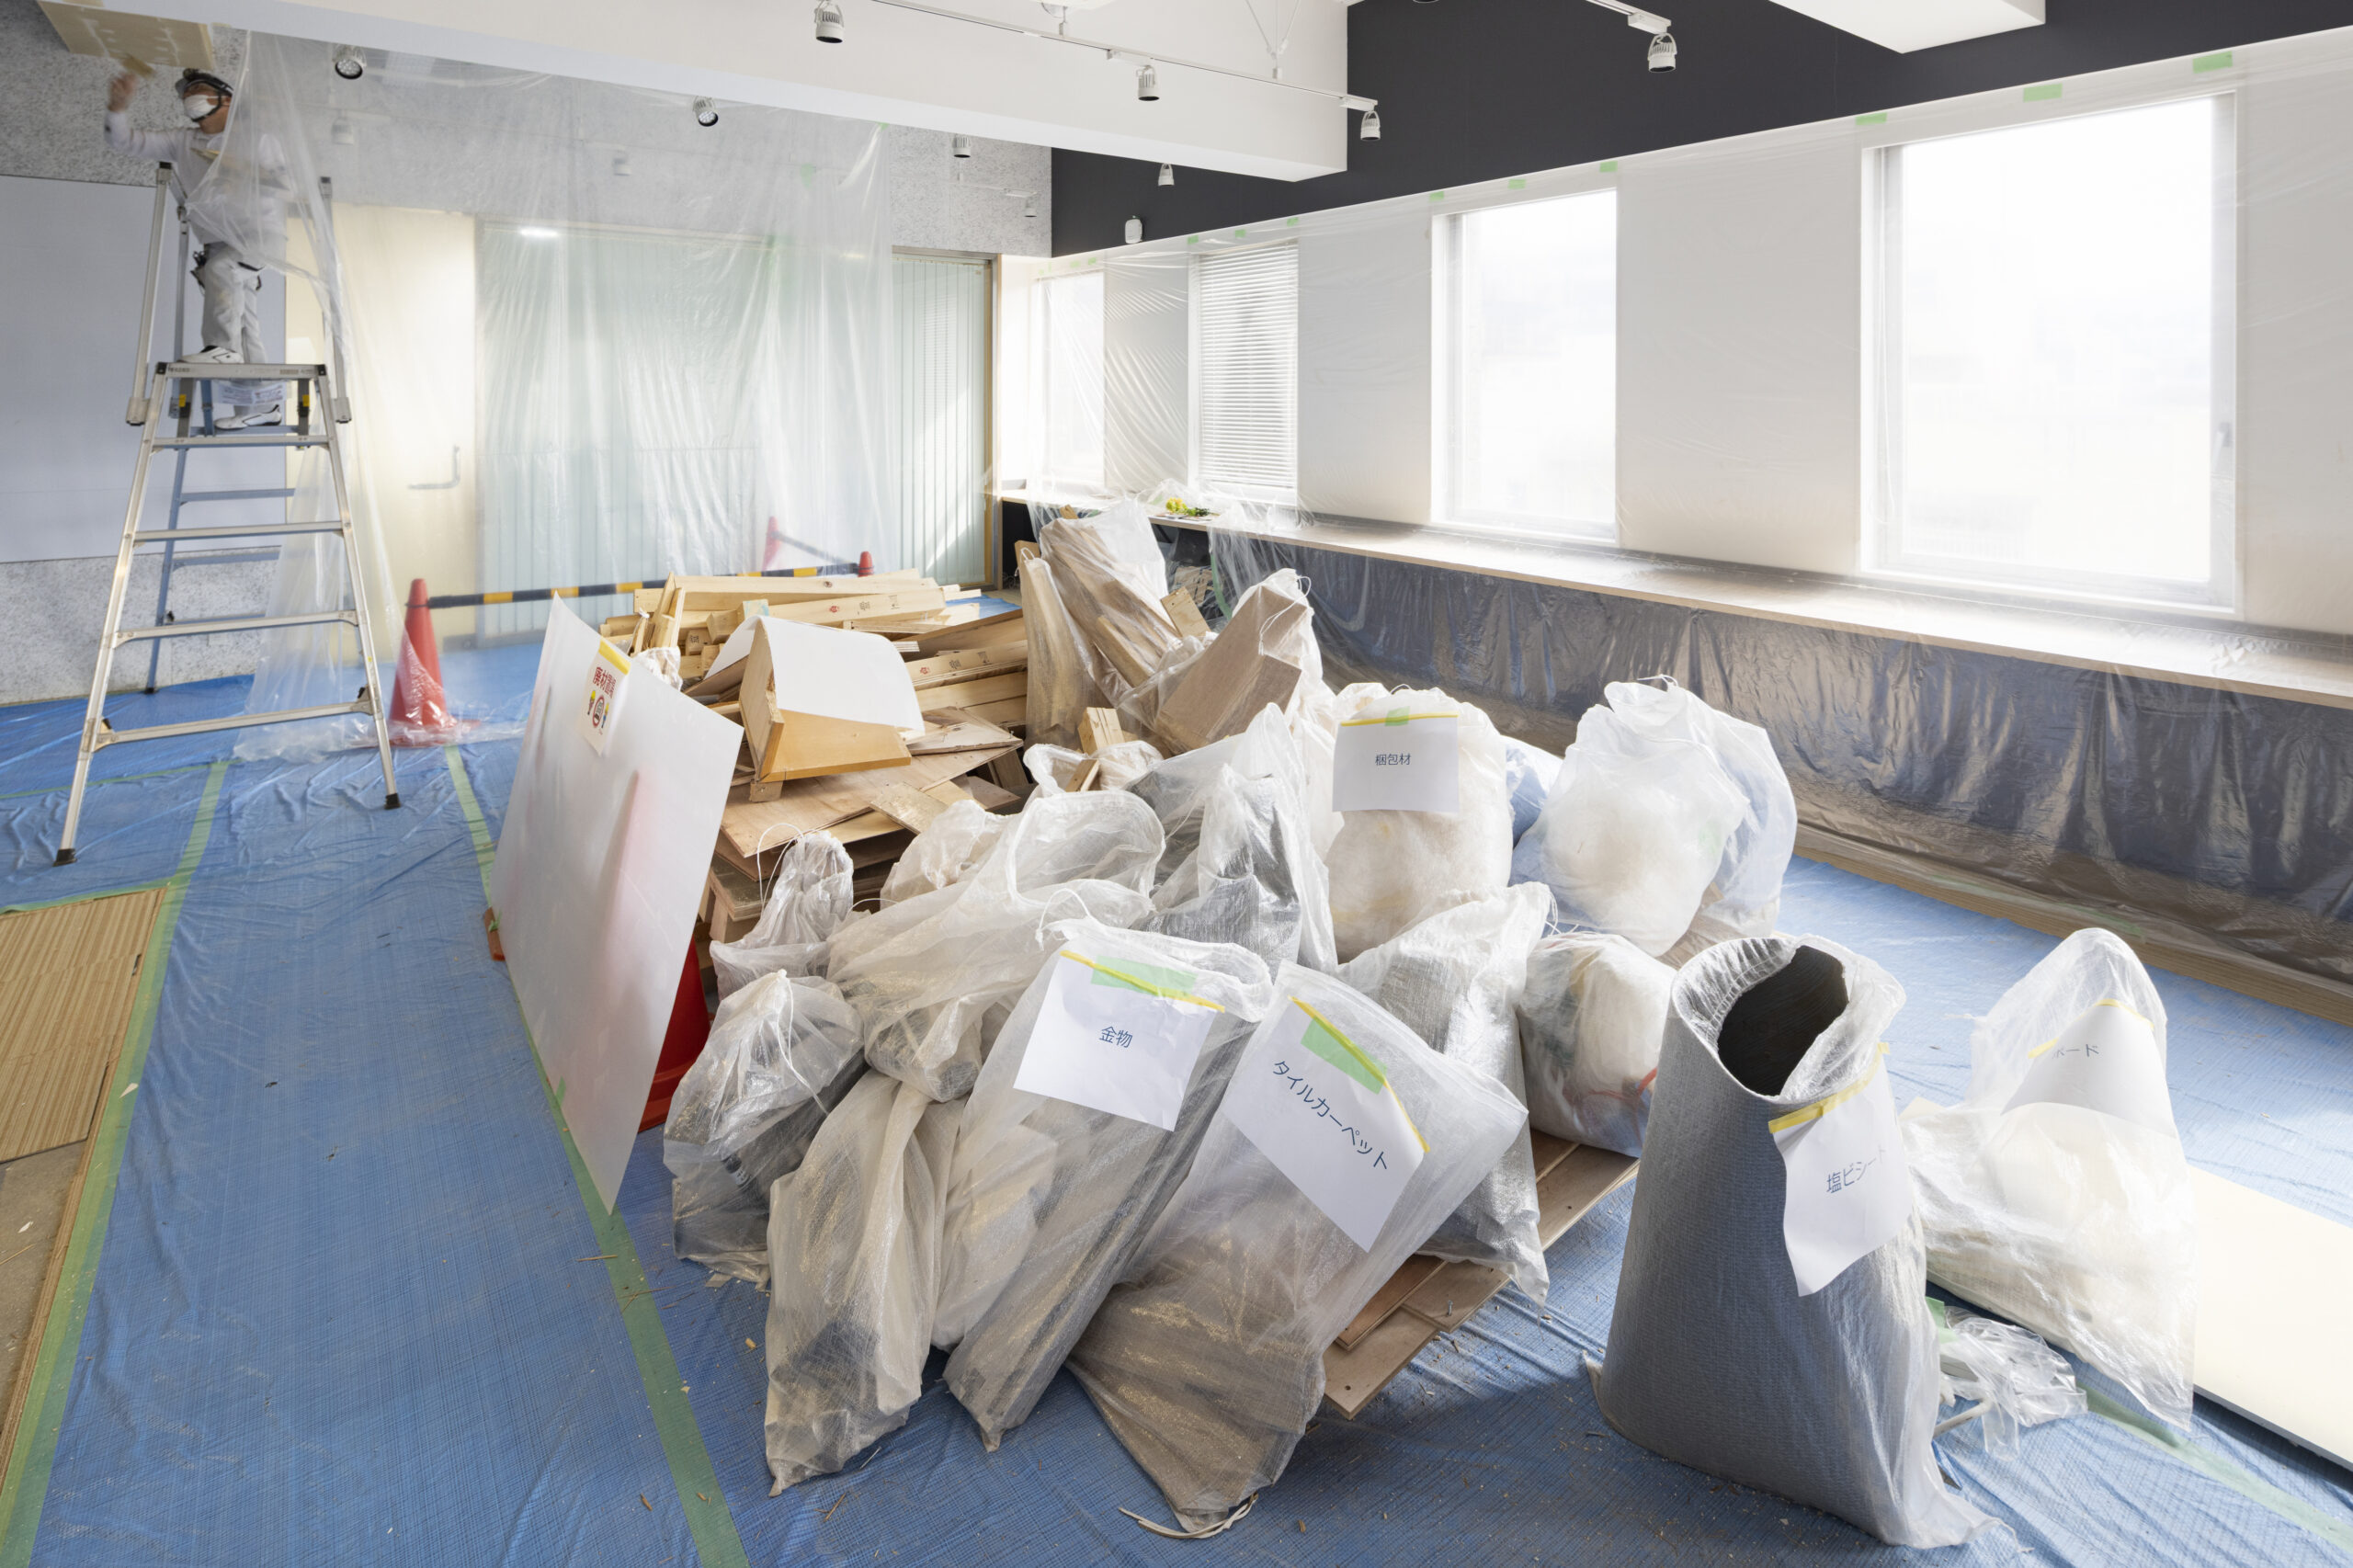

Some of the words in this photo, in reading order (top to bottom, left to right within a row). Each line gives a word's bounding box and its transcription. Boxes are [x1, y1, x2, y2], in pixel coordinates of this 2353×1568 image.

[1375, 754, 1411, 766] 梱包材
[1099, 1026, 1132, 1048] 金物
[1273, 1061, 1387, 1169] タイルカーペット
[1826, 1143, 1885, 1193] 塩ビシート
